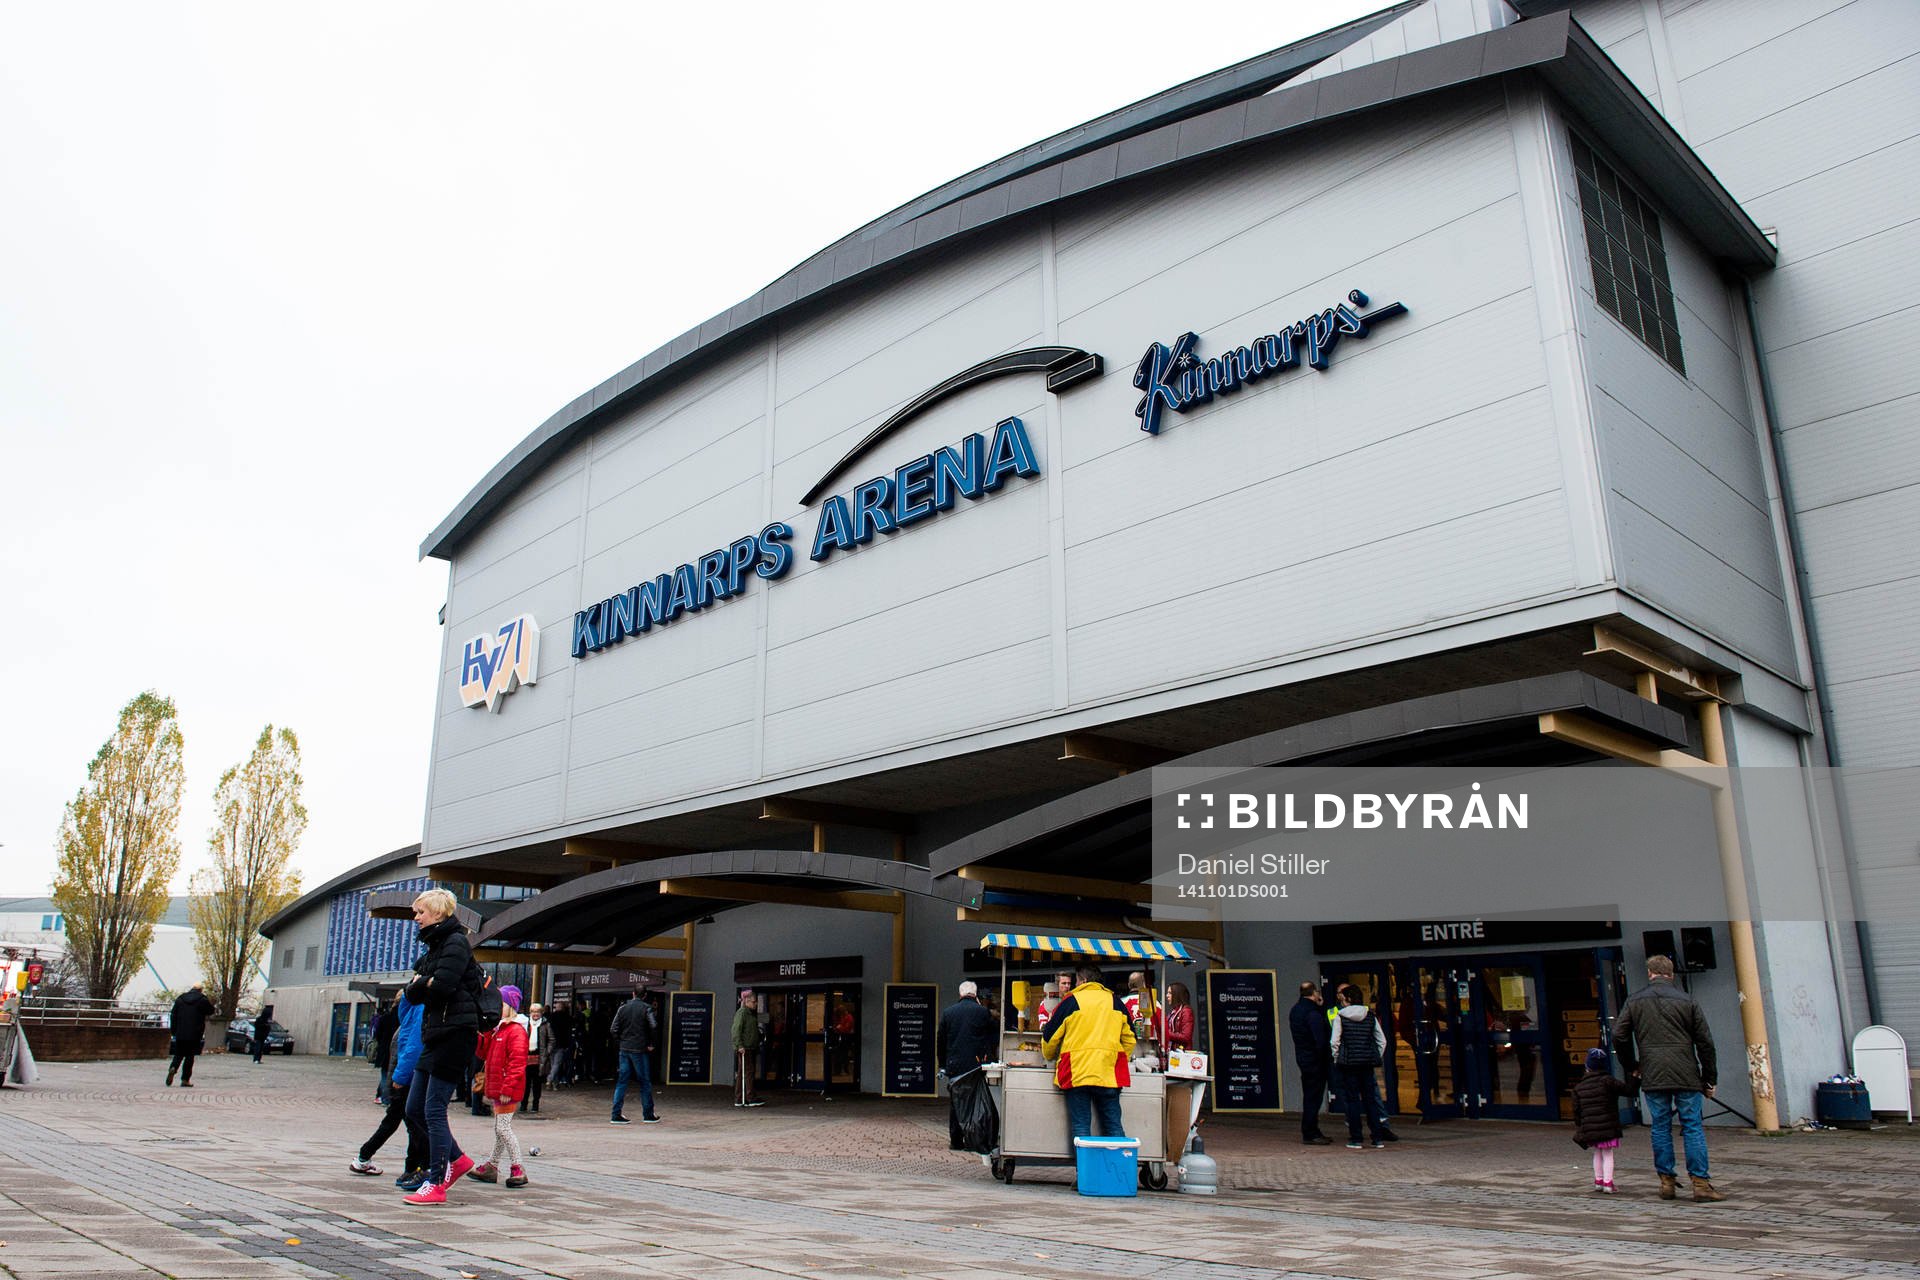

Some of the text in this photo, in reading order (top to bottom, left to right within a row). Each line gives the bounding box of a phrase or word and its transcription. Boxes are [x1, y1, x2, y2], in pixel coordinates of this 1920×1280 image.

[1133, 300, 1409, 435] Kinnarps
[572, 415, 1040, 659] KINNARPS ARENA
[460, 616, 526, 694] HV71
[1421, 917, 1485, 941] ENTRÉ
[779, 960, 807, 976] ENTRÉ
[1227, 993, 1263, 1003] Husqvarna
[1569, 1023, 1576, 1033] 2
[1572, 1053, 1579, 1062] 4
